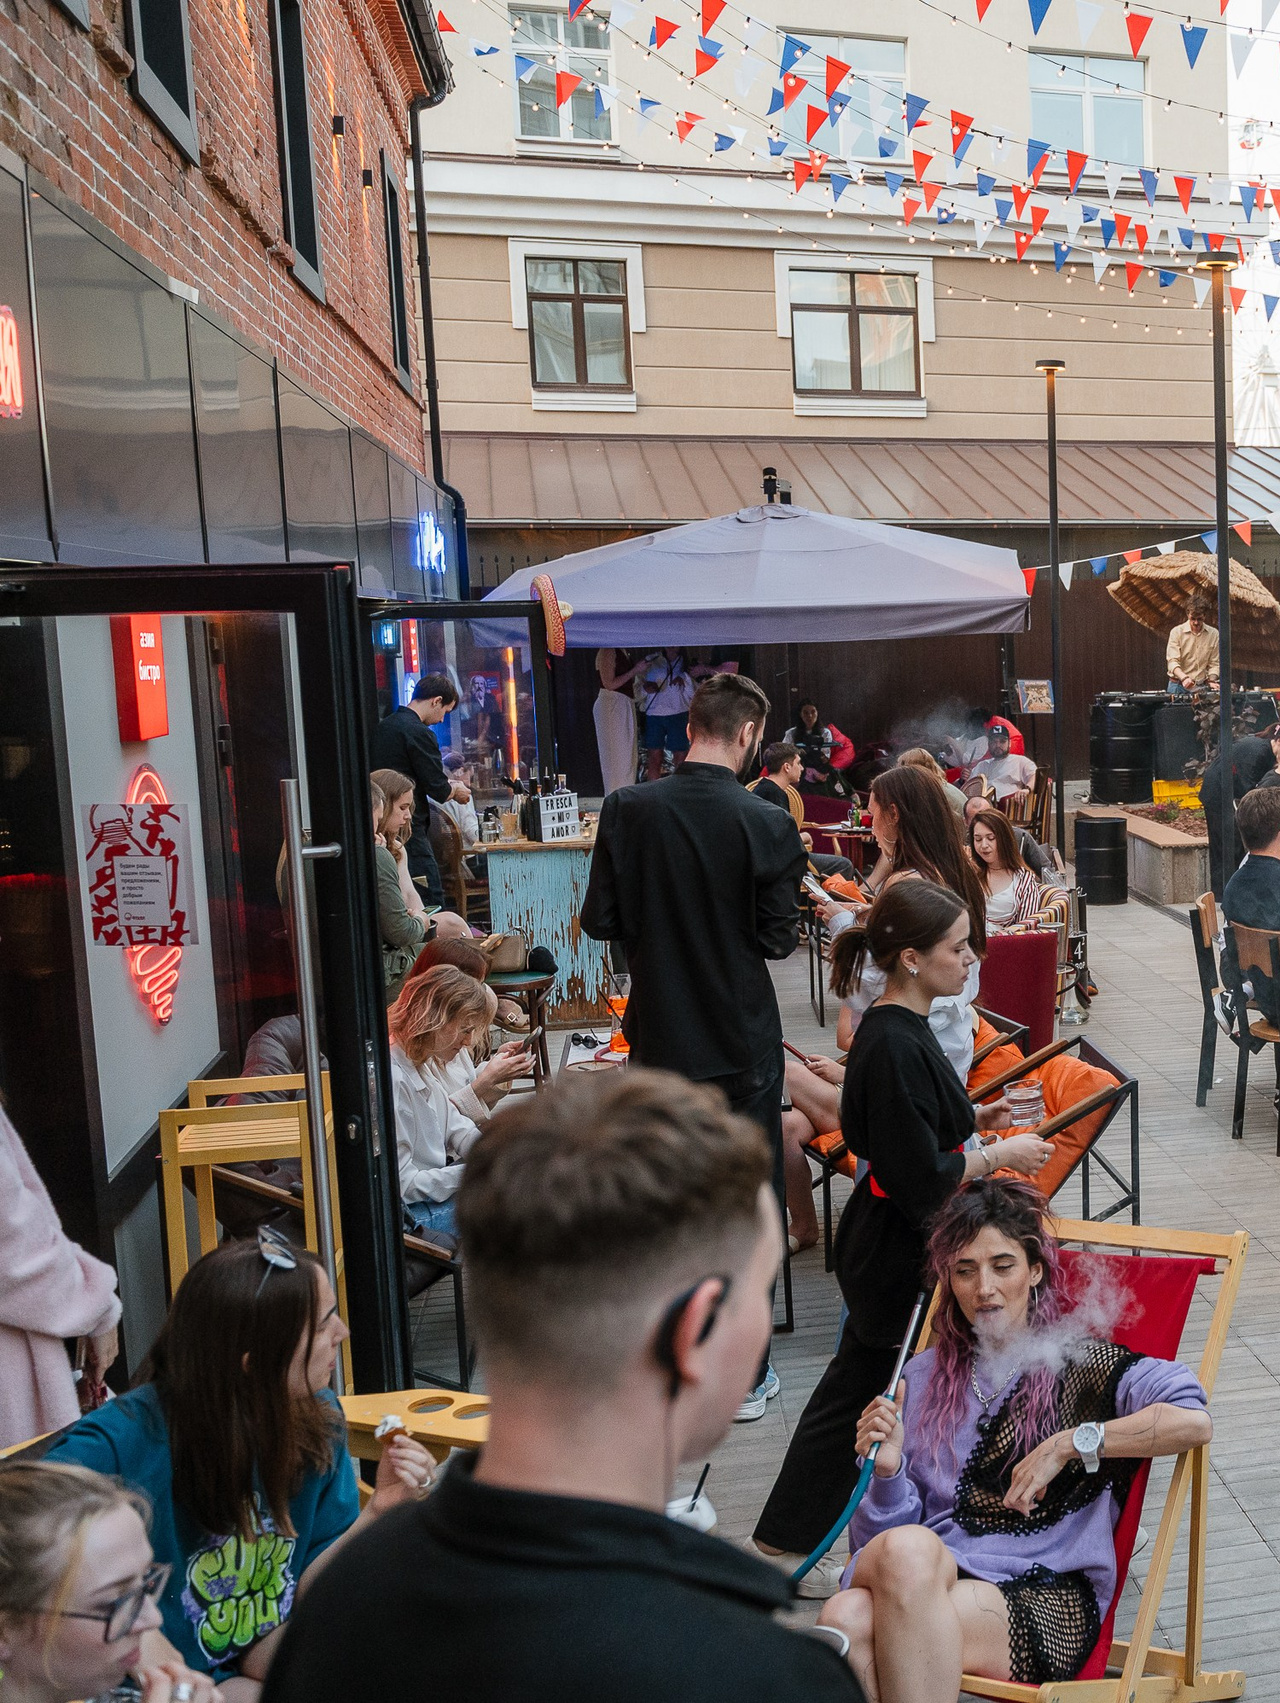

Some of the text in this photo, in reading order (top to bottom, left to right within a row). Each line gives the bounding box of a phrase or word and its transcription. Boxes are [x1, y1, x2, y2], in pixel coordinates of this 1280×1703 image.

[139, 632, 155, 648] азия
[138, 659, 161, 686] бистро
[545, 796, 573, 811] FRESCA
